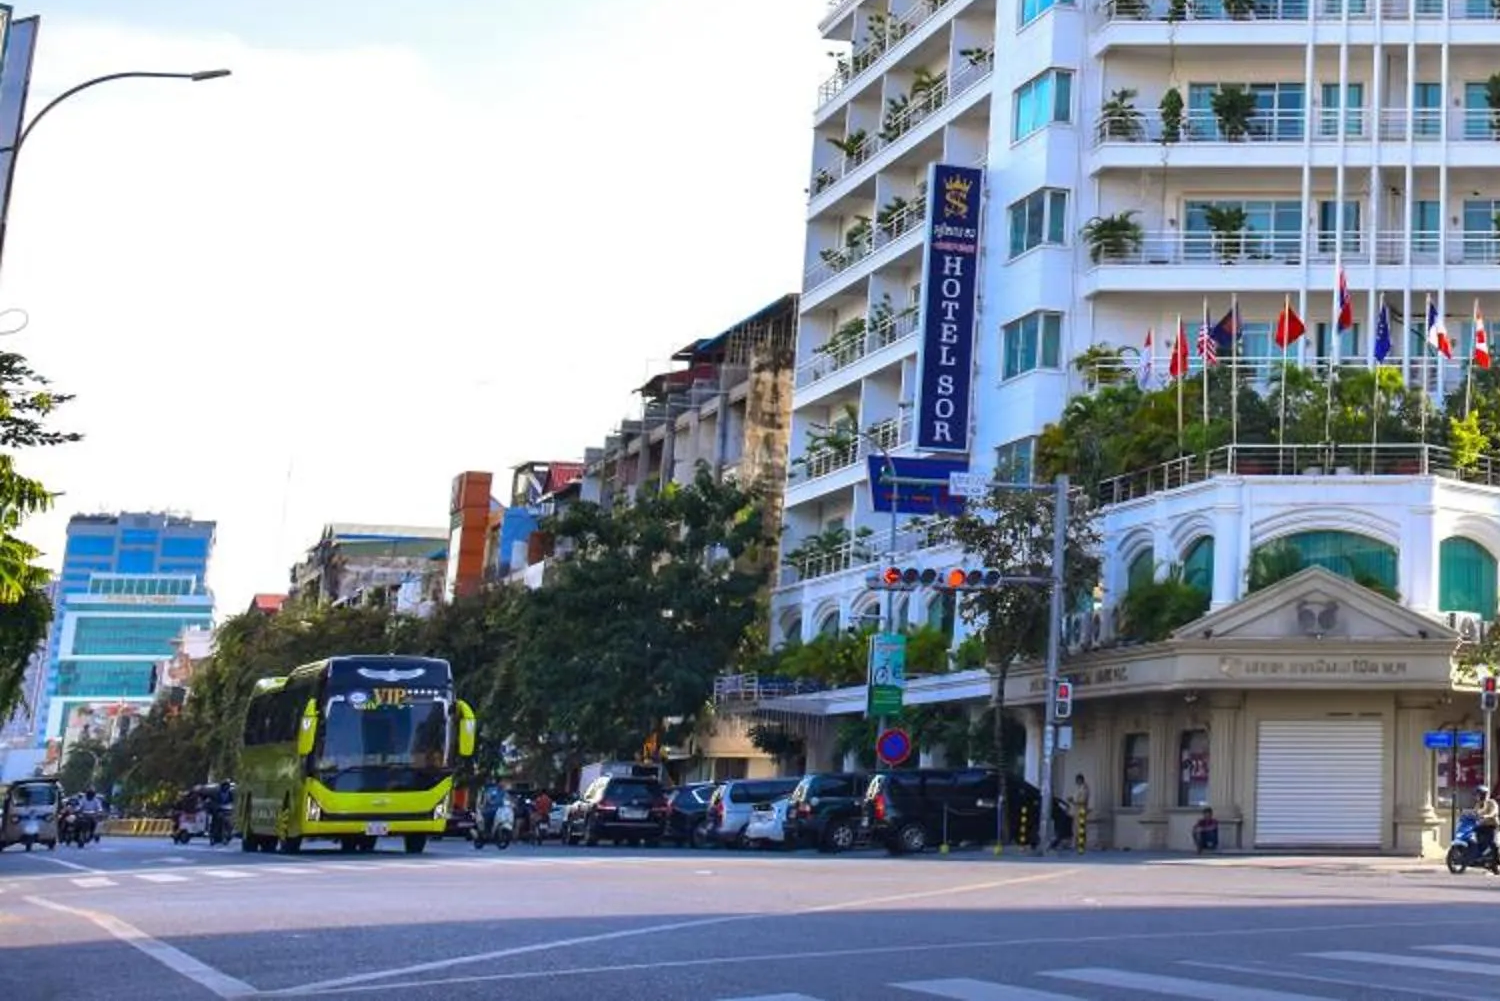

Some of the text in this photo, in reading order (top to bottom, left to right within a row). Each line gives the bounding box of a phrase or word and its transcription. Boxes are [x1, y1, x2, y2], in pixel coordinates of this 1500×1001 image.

[938, 255, 964, 366] HOTEL
[932, 375, 956, 443] SOR
[373, 687, 407, 705] VIP
